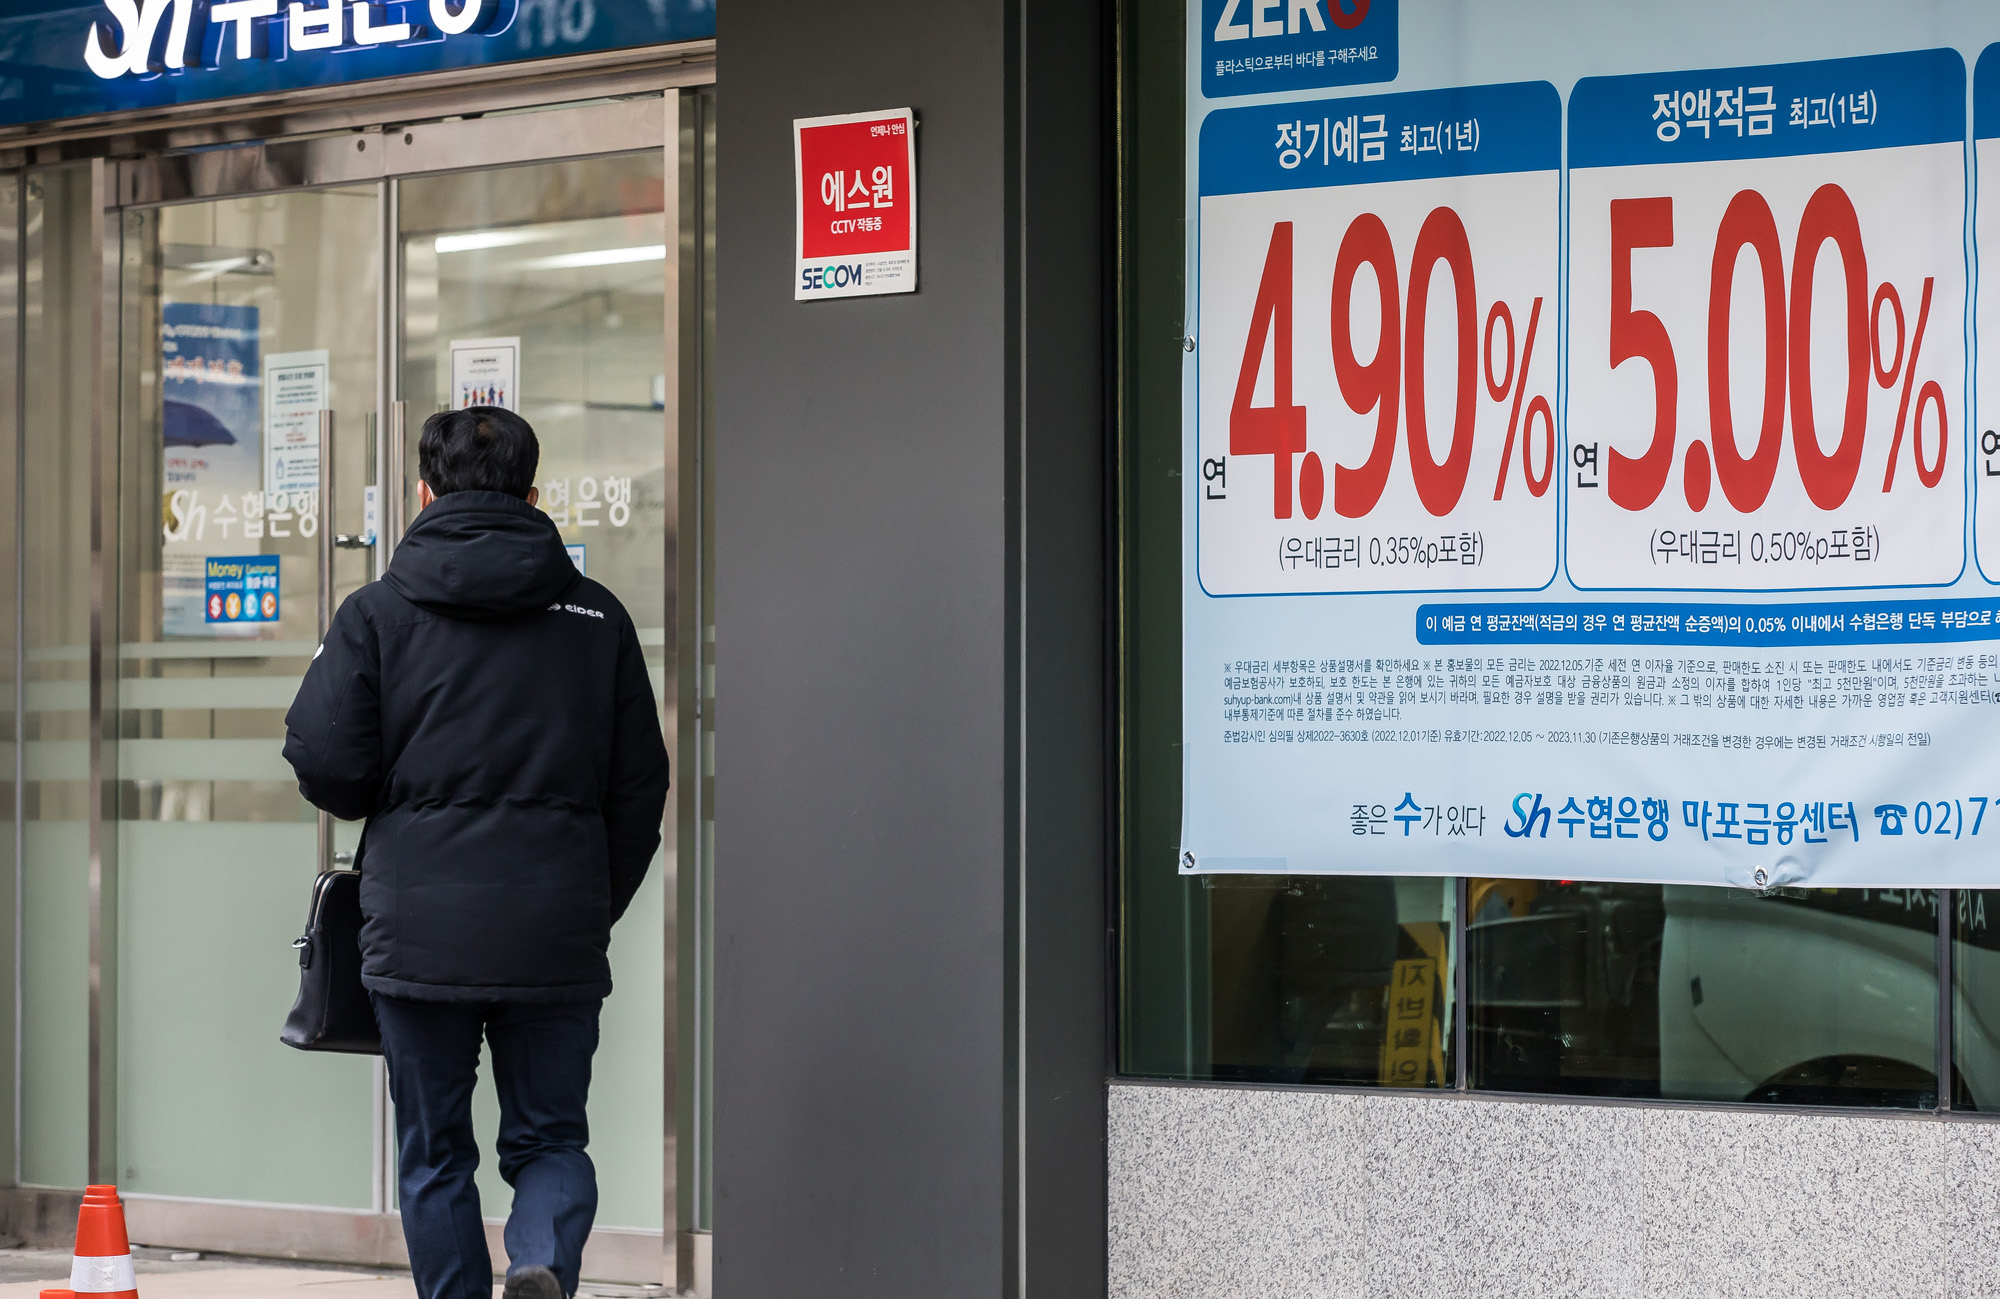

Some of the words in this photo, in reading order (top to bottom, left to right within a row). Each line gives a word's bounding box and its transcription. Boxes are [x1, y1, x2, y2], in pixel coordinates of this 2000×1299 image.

[1215, 53, 1293, 76] 플라스틱으로부터
[1296, 50, 1325, 68] 바다를
[1328, 46, 1378, 65] 구해주세요
[1651, 85, 1777, 143] 정액적금
[1789, 88, 1878, 129] 최고(1년)
[870, 125, 890, 137] 언제나
[892, 123, 905, 135] 안심
[1275, 114, 1388, 170] 정기예금
[1399, 118, 1479, 155] 최고(1년)
[821, 165, 893, 212] 에스원
[831, 219, 856, 234] CCTV
[857, 217, 882, 231] 작동중
[802, 264, 862, 289] SECOM
[1202, 455, 1228, 501] 연
[1230, 206, 1554, 521] 4.90%
[1574, 442, 1599, 489] 연
[1608, 183, 1948, 515] 5.00%
[164, 489, 206, 542] Sh
[213, 490, 318, 538] 수협은행
[545, 476, 631, 527] 협은행
[1278, 535, 1361, 572] (우대금리
[1369, 529, 1484, 571] 0.35%p포함)
[1649, 527, 1741, 568] (우대금리
[1751, 523, 1880, 567] 0.50%p포함)
[208, 562, 243, 579] Money
[1426, 615, 1437, 632] 이
[1442, 615, 1465, 631] 예금
[1470, 615, 1482, 631] 연
[1487, 613, 1578, 631] 평균잔액(적금의
[1583, 614, 1607, 631] 경우
[1613, 614, 1625, 631] 연
[1630, 614, 1680, 632] 평균잔액
[1685, 615, 1741, 634] 순증액)의
[1746, 617, 1786, 633] 0.05%
[1792, 615, 1844, 632] 이내에서
[1849, 612, 1903, 631] 수협은행
[1909, 612, 1936, 630] 단독
[1940, 610, 1992, 629] 부담으로
[1235, 660, 1269, 673] 우대금리
[1273, 660, 1315, 673] 세부항목은
[1320, 659, 1372, 673] 상품설명서를
[1375, 659, 1419, 672] 확인하세요
[1434, 659, 1443, 671] 본
[1447, 658, 1482, 672] 홍보물의
[1487, 659, 1504, 671] 모든
[1508, 658, 1535, 672] 금리는
[1608, 659, 1627, 672] 세전
[1632, 659, 1640, 672] 연
[1645, 659, 1673, 673] 이자율
[1723, 660, 1761, 675] 판매한도
[1765, 661, 1785, 675] 소진
[1789, 661, 1798, 674] 시
[1803, 660, 1823, 674] 또는
[1828, 659, 1866, 674] 판매한도
[1872, 658, 1912, 673] 내에서도
[1917, 657, 1953, 671] 기준금리
[1978, 654, 1998, 669] 등의
[1224, 676, 1284, 690] 예금보험공사가
[1330, 676, 1347, 688] 보호
[1352, 675, 1377, 688] 한도는
[1383, 675, 1391, 688] 본
[1396, 675, 1422, 688] 은행에
[1427, 675, 1444, 688] 있는
[1450, 674, 1476, 688] 귀하의
[1482, 675, 1500, 688] 모든
[1505, 674, 1551, 688] 예금자보호
[1557, 674, 1575, 688] 대상
[1582, 675, 1630, 689] 금융상품의
[1636, 675, 1666, 690] 원금과
[1672, 677, 1700, 690] 소정의
[1705, 677, 1735, 691] 이자를
[1741, 678, 1770, 692] 합하여
[1777, 678, 1801, 692] 1인당
[1904, 674, 1944, 690] 5천만원을
[1948, 673, 1988, 687] 초과하는
[1224, 707, 1284, 722] 내부통제기준에
[1287, 707, 1304, 721] 따른
[1308, 707, 1333, 721] 절차를
[1335, 707, 1353, 721] 준수
[1356, 707, 1402, 720] 하였습니다.
[1306, 692, 1322, 705] 상품
[1326, 691, 1352, 705] 설명서
[1356, 691, 1365, 705] 및
[1369, 691, 1395, 705] 약관을
[1399, 691, 1415, 704] 읽어
[1420, 691, 1446, 705] 보시기
[1483, 691, 1510, 705] 필요한
[1514, 691, 1532, 705] 경우
[1537, 691, 1563, 705] 설명을
[1567, 691, 1586, 705] 받을
[1590, 691, 1619, 706] 권리가
[1680, 694, 1689, 705] 그
[1716, 695, 1746, 709] 상품에
[1751, 695, 1769, 710] 대한
[1774, 694, 1804, 710] 자세한
[1809, 694, 1837, 709] 내용은
[1842, 693, 1873, 708] 가까운
[1877, 692, 1905, 708] 영업점
[1909, 692, 1926, 706] 혹은
[1224, 730, 1265, 743] 준법감시인
[1269, 730, 1294, 743] 심의필
[1548, 731, 1596, 744] 2023.11.30
[1599, 731, 1670, 745] (기존은행상품의
[1673, 733, 1719, 747] 거래조건을
[1722, 734, 1751, 748] 변경한
[1756, 736, 1794, 750] 경우에는
[1797, 735, 1826, 749] 변경된
[1830, 734, 1867, 748] 거래조건
[1869, 733, 1904, 747] 시행일의
[1907, 732, 1931, 746] 전일)
[1349, 803, 1388, 836] 좋은
[1503, 792, 1550, 839] Sh
[1557, 796, 1670, 840] 수협은행
[1682, 799, 1861, 845] 마포금융센터
[1912, 796, 2000, 839] 02)7
